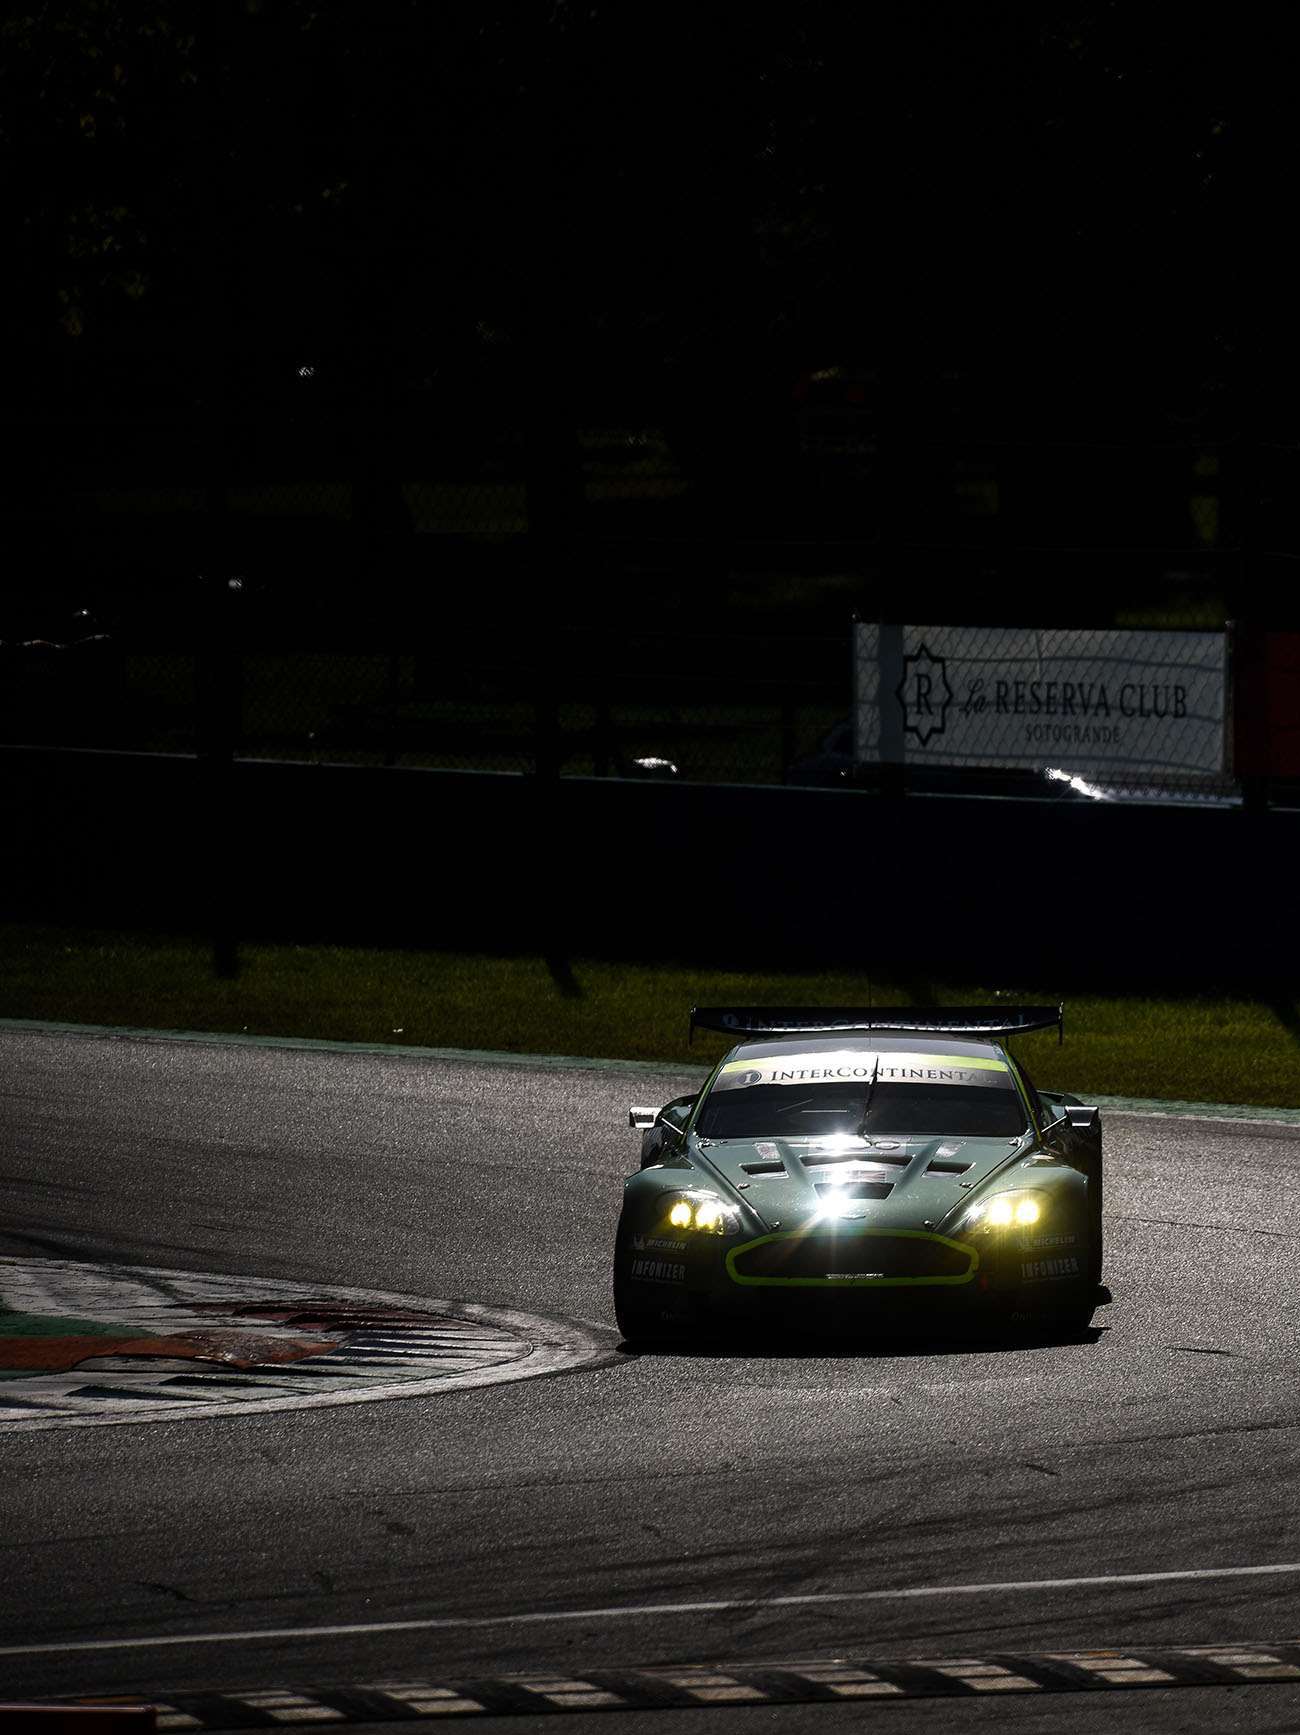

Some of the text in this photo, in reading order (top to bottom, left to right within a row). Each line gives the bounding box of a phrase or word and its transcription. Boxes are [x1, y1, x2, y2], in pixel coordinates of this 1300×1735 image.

[916, 674, 935, 715] R
[996, 681, 1112, 718] RESERVA
[1119, 684, 1187, 719] CLUB
[1025, 723, 1121, 744] SOTOGRANDE
